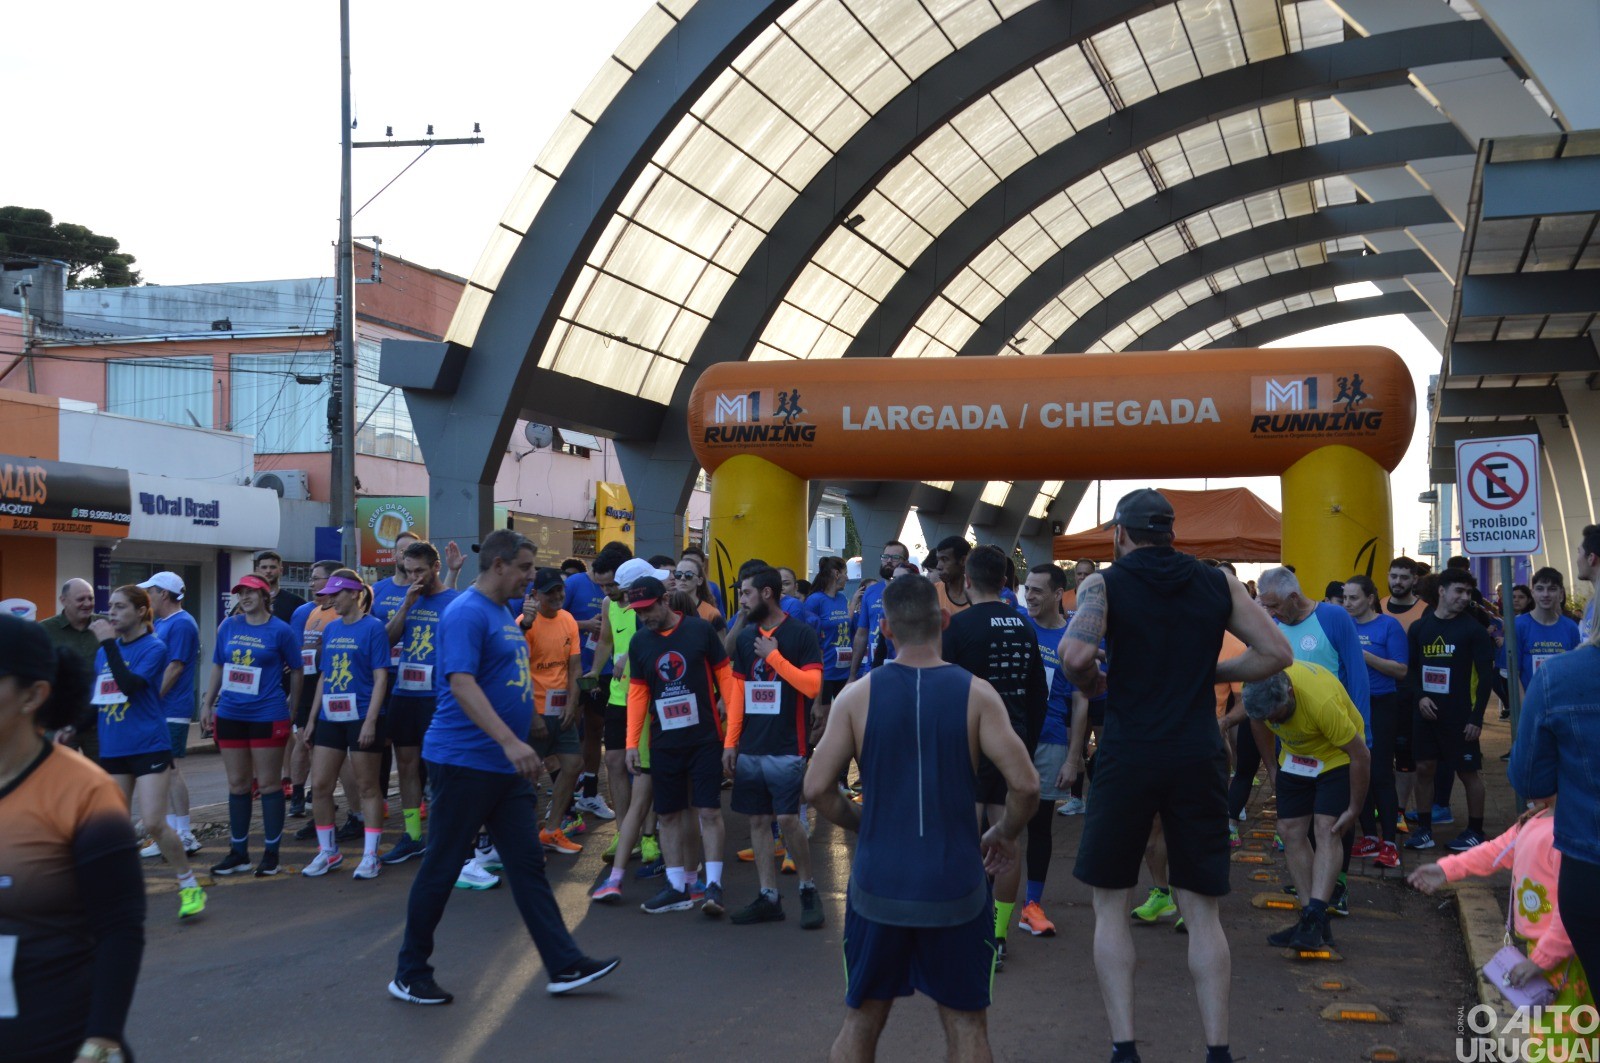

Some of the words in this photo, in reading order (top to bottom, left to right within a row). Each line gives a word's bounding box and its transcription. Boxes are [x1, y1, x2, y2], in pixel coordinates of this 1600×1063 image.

[1265, 377, 1317, 411] M1
[715, 391, 761, 423] M1
[842, 404, 1009, 431] LARGADA
[1039, 397, 1221, 429] CHEGADA
[1250, 411, 1383, 433] RUNNING
[704, 425, 817, 443] RUNNING
[156, 494, 182, 516] Oral
[184, 497, 220, 519] Brasil
[13, 518, 39, 531] BAZAR
[368, 505, 385, 528] CREPE
[396, 504, 415, 527] PRAÇA
[1472, 516, 1528, 529] PROIBIDO
[1465, 529, 1536, 542] ESTACIONAR
[990, 616, 1024, 627] ATLETA
[755, 690, 774, 701] 059
[667, 704, 689, 716] 116
